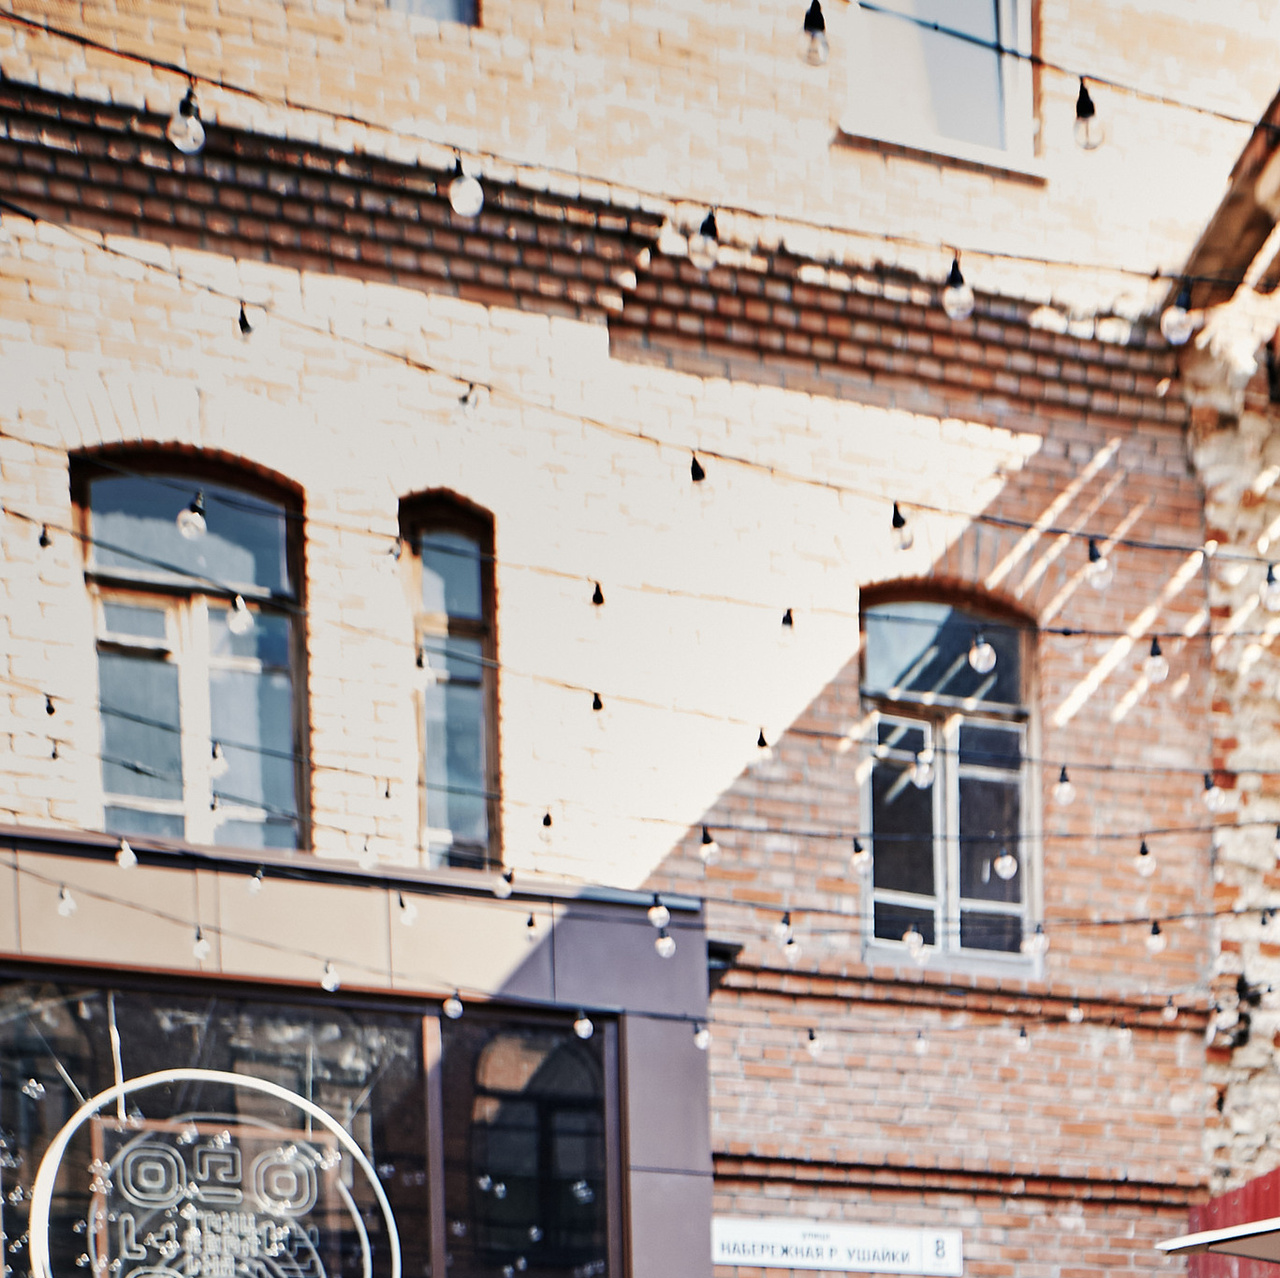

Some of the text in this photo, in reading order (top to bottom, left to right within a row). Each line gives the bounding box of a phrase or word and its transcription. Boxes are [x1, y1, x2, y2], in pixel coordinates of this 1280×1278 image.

[721, 1242, 824, 1259] НАБЕРЕЖНАЯ
[847, 1246, 910, 1263] УШАЙКИ
[935, 1238, 946, 1259] 8
